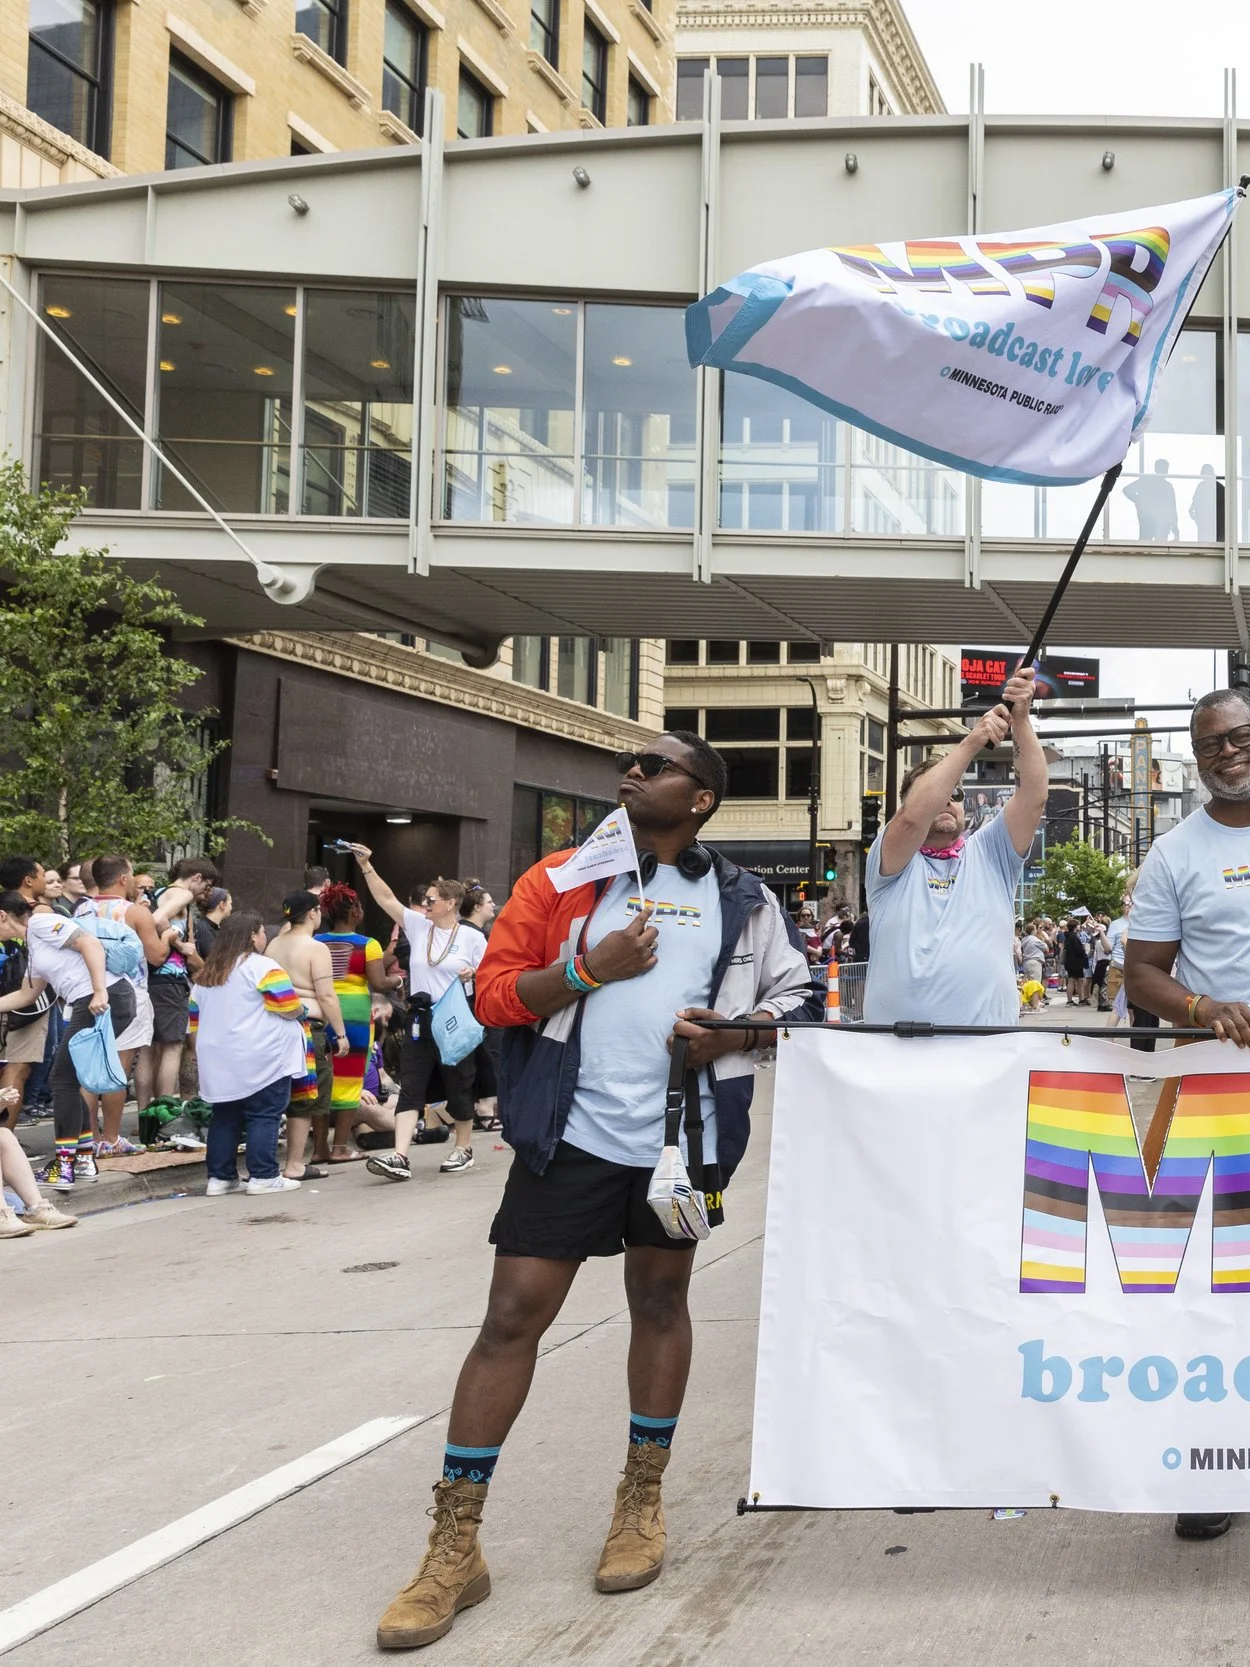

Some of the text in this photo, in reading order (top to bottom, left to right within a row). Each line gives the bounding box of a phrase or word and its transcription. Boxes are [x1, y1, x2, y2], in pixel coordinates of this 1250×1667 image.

[948, 368, 1009, 400] MINNESOTA
[1009, 390, 1045, 413] PUBLIC
[961, 658, 1007, 673] OJA CAT
[776, 864, 810, 874] Center
